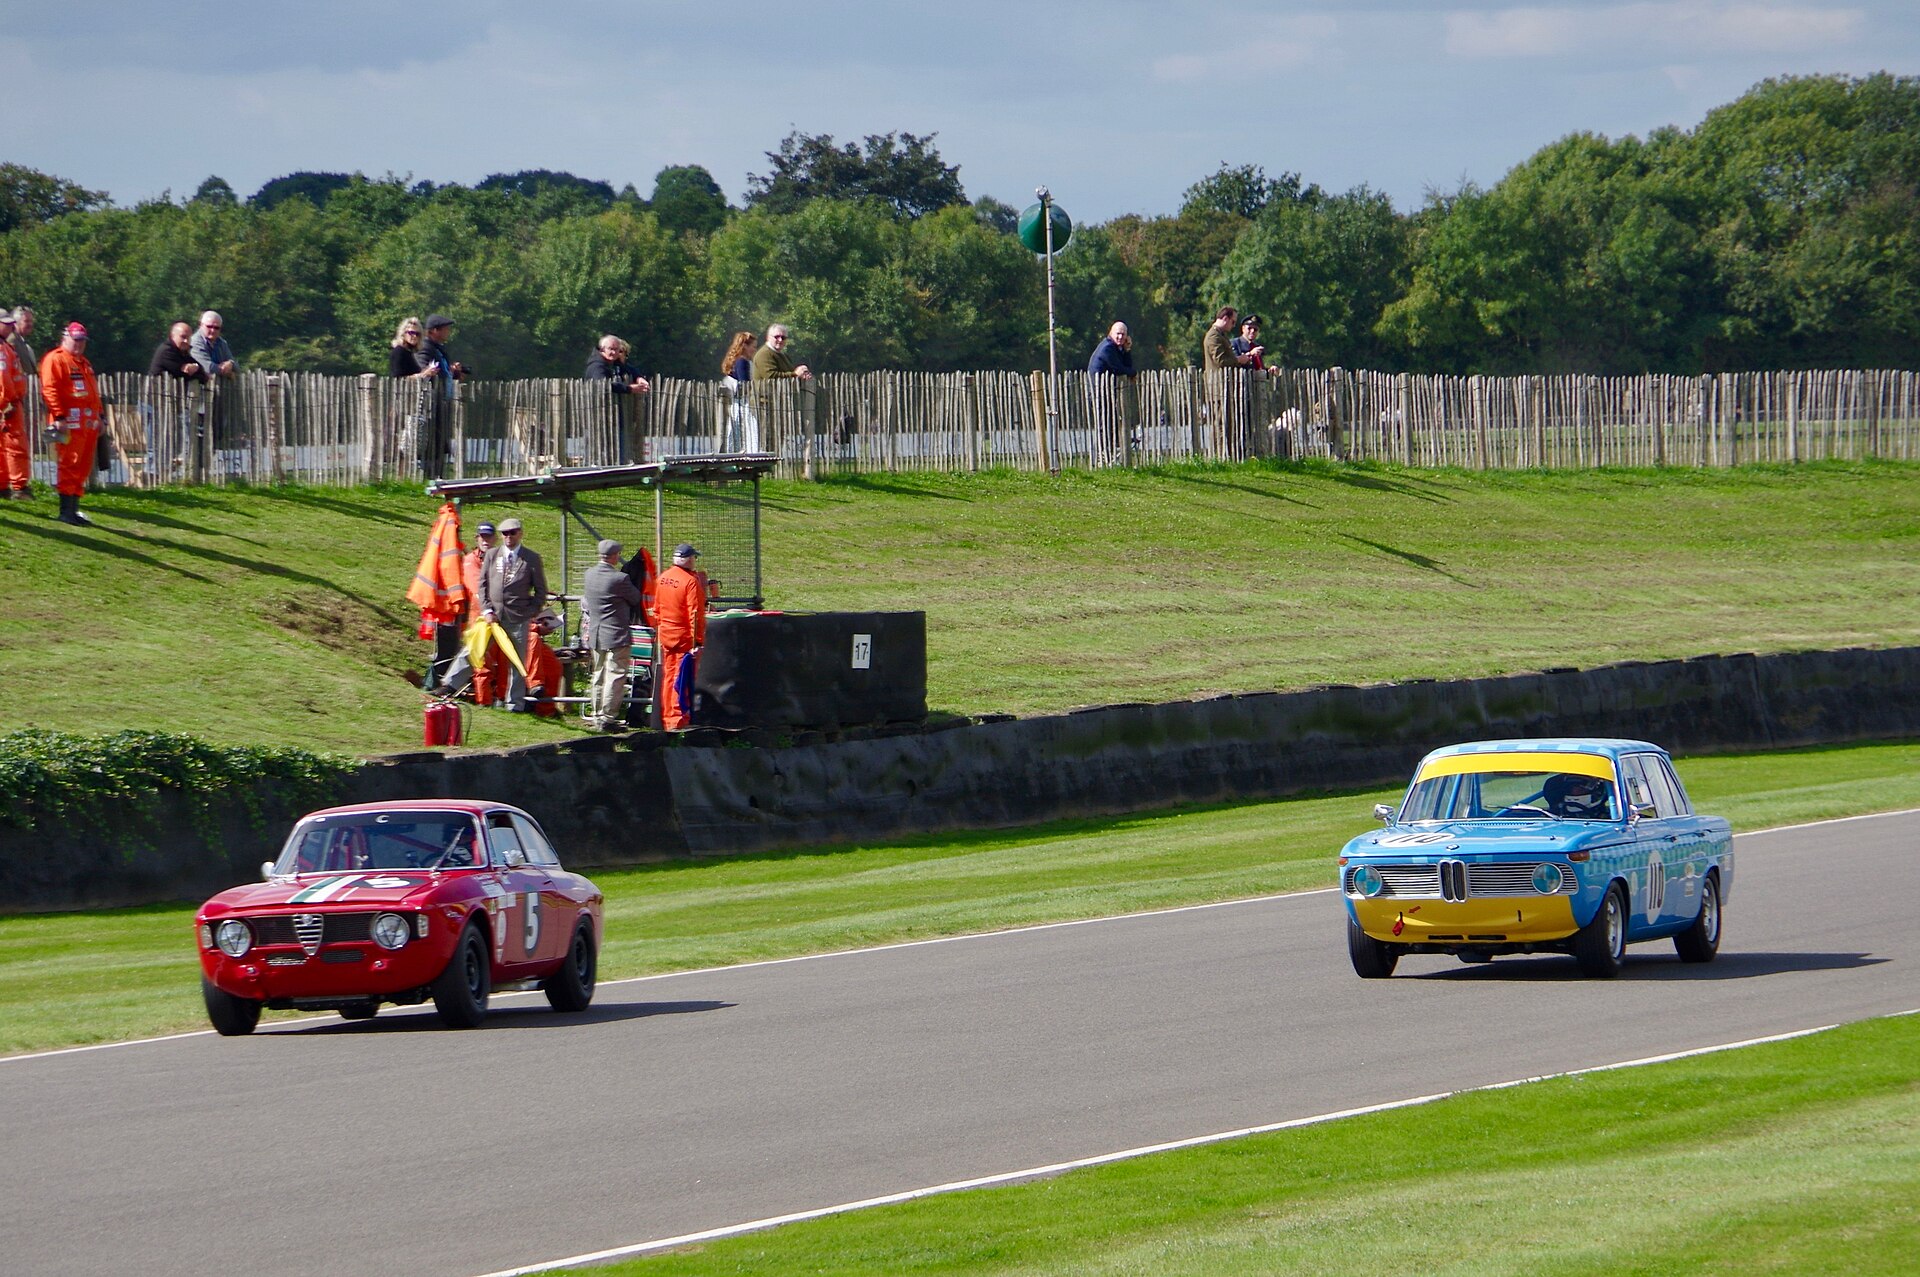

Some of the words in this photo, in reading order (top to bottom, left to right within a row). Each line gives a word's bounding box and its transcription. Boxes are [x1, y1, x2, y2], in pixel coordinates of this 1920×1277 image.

[660, 577, 680, 589] BARC
[856, 642, 869, 660] 17
[1386, 834, 1451, 844] 110
[365, 877, 410, 888] 5
[1648, 862, 1664, 910] 110
[525, 892, 539, 949] 5
